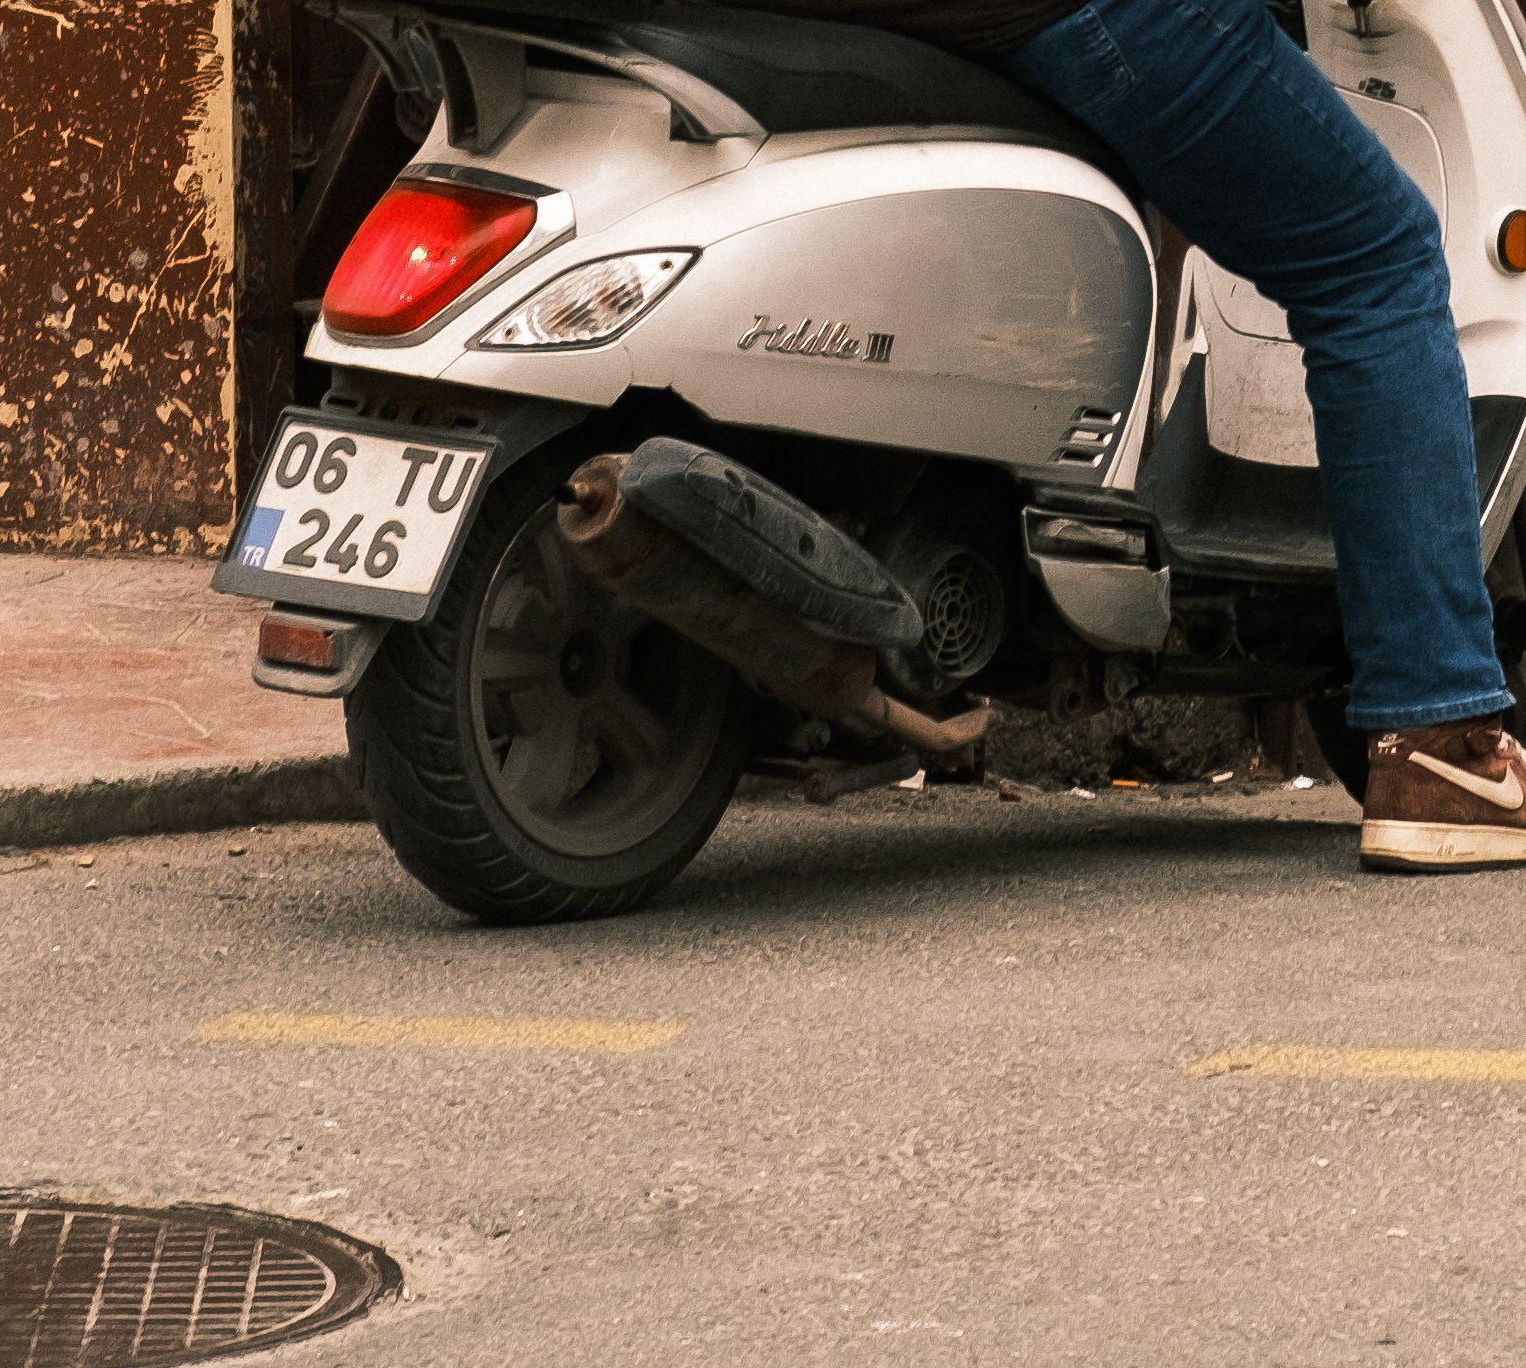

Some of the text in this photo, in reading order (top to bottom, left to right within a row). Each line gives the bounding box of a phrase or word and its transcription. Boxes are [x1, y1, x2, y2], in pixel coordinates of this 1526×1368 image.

[275, 431, 478, 513] 06 TU
[242, 544, 267, 568] TR
[282, 508, 407, 579] 246
